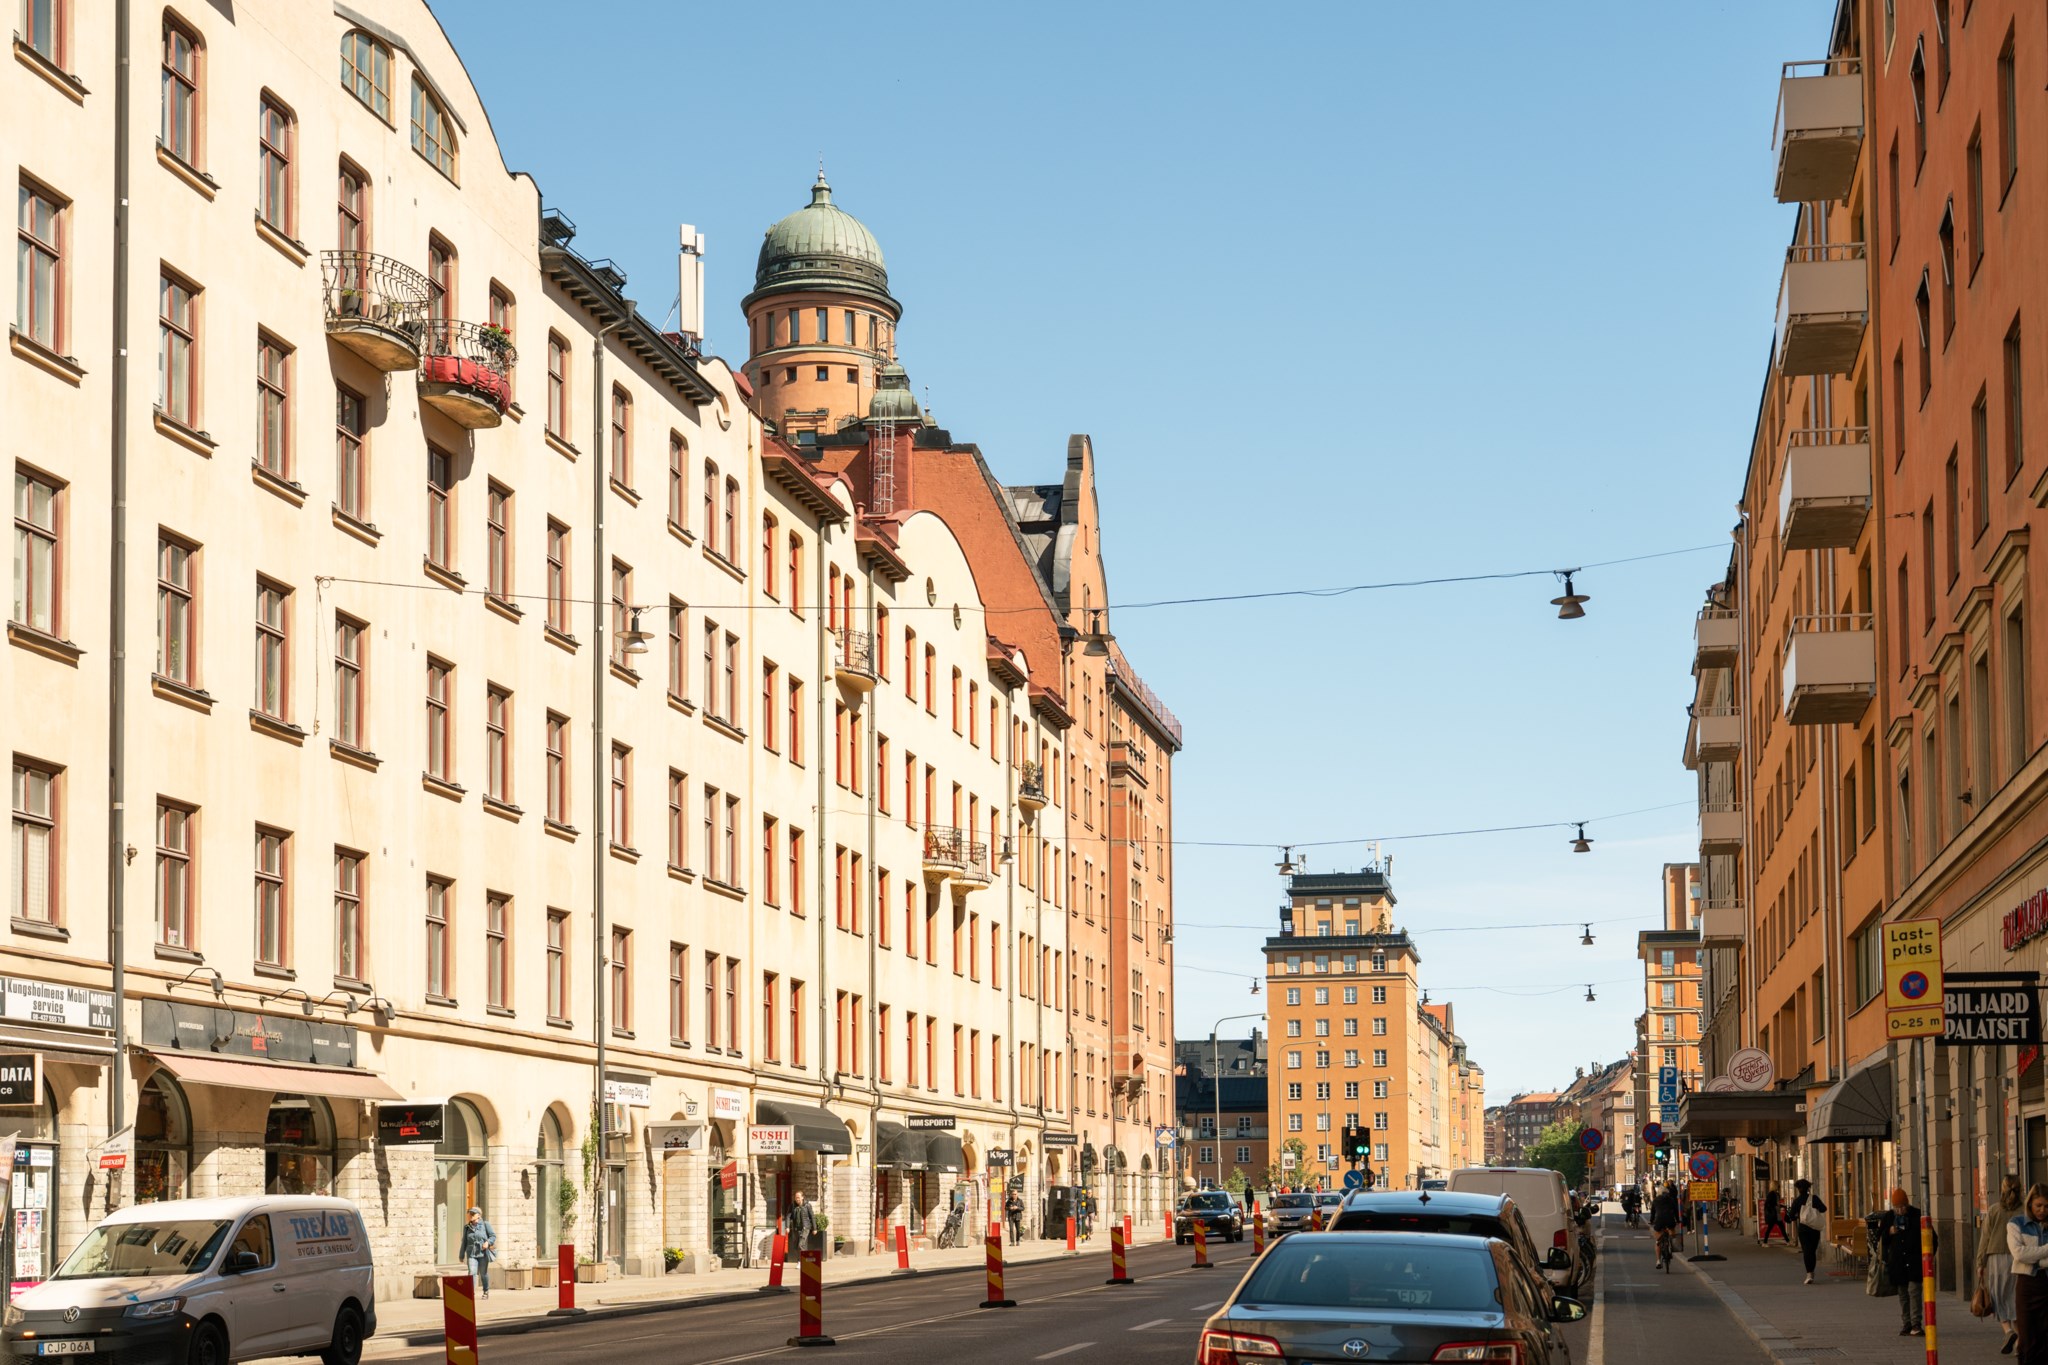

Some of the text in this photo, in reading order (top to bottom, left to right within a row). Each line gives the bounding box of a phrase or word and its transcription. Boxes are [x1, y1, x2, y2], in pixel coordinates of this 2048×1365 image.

[1891, 927, 1934, 942] Last-
[1892, 944, 1933, 960] plats
[7, 978, 64, 1001] Kungsholmens
[67, 987, 88, 1004] Mobil
[33, 1000, 64, 1014] service
[90, 993, 113, 1008] MOBIL
[1945, 992, 2030, 1015] BILJARD
[92, 1013, 112, 1027] DATA
[1891, 1017, 1940, 1030] 0-25 m
[1944, 1018, 2030, 1040] PALATSET
[0, 1067, 32, 1082] DATA
[1663, 1068, 1674, 1083] P
[618, 1085, 644, 1099] Smiling Dog
[716, 1096, 730, 1110] SUSHI
[909, 1118, 953, 1127] MM SPORTS
[751, 1131, 788, 1140] SUSHI
[14, 1150, 26, 1159] yca
[100, 1158, 124, 1166] maxell
[289, 1211, 349, 1239] TREXAB
[297, 1244, 354, 1257] BYGG & SANERING
[47, 1341, 91, 1353] CJP 06A
